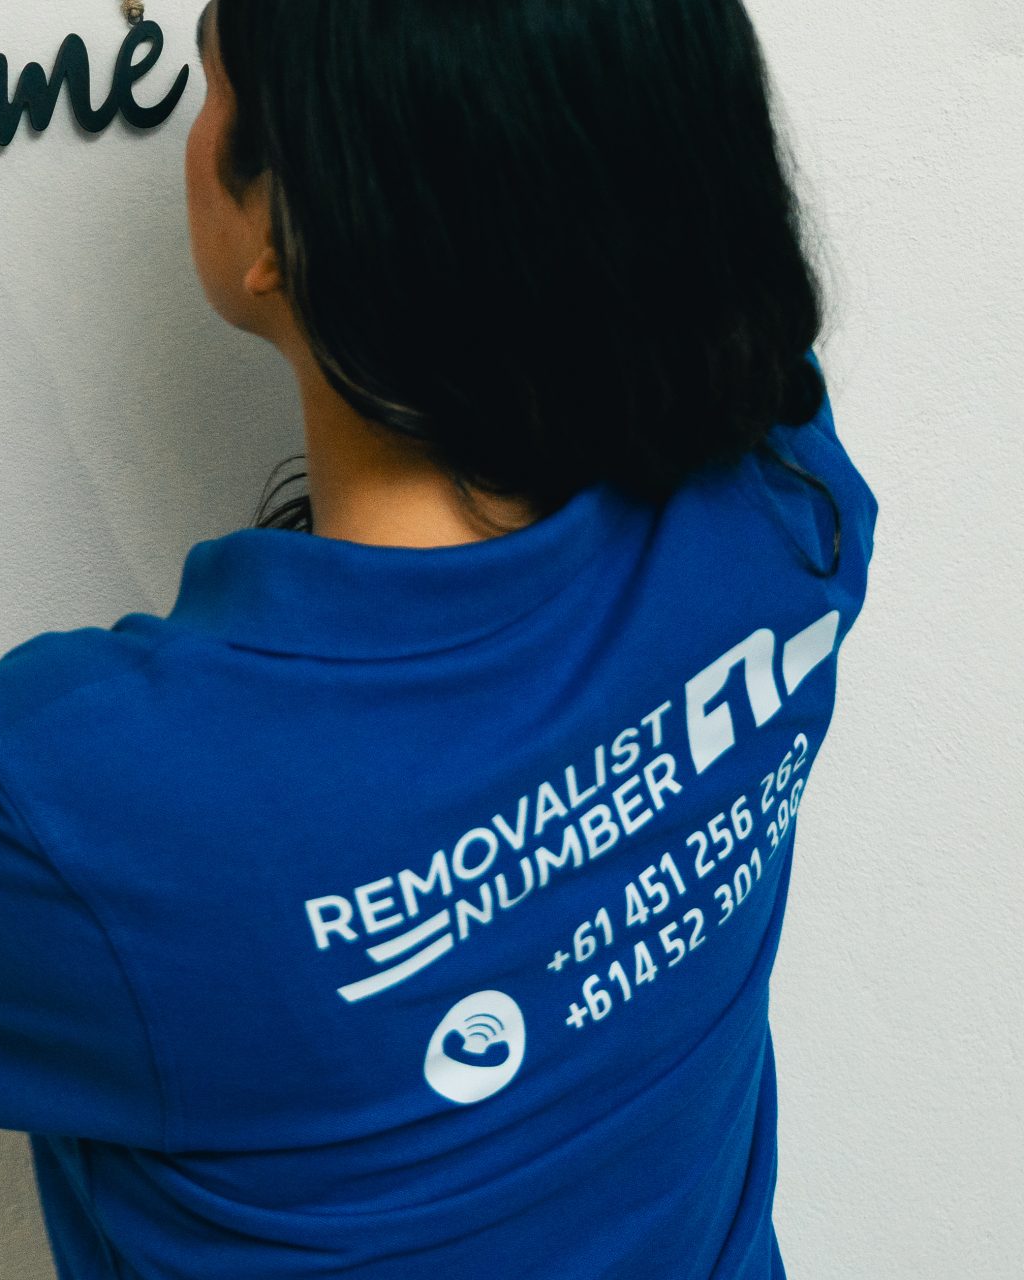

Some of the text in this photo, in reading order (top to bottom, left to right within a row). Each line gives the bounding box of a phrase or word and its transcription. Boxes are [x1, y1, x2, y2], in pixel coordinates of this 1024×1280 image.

[305, 701, 672, 949] REMOVALIST
[449, 753, 682, 940] NUMBER
[547, 732, 808, 971] +61 451 256 262
[714, 847, 762, 926] 301
